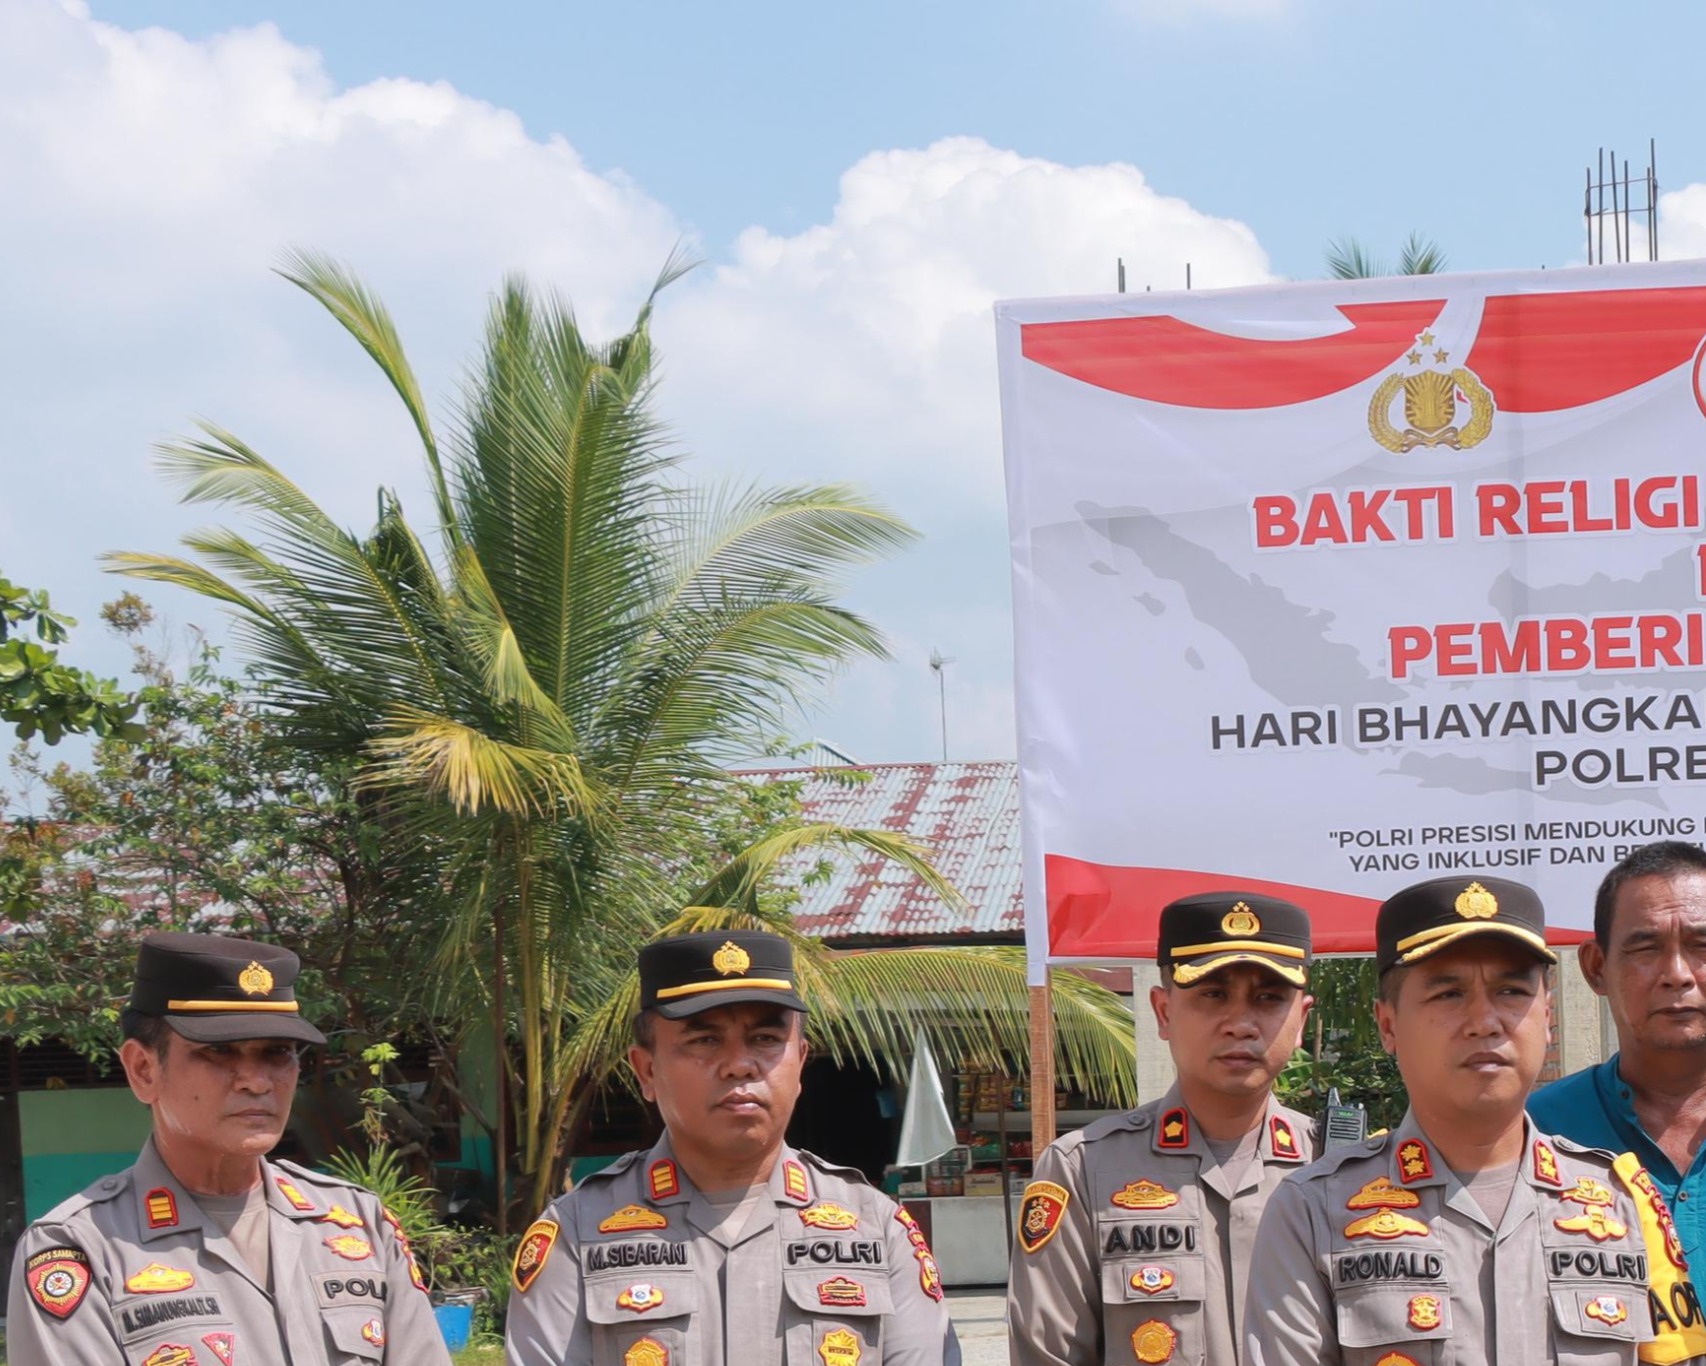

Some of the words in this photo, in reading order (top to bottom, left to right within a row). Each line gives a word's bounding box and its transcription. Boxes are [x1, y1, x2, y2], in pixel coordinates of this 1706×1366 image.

[1253, 486, 1454, 547] BAKTI
[1477, 474, 1699, 536] RELIGI
[1211, 710, 1337, 750] HARI
[1329, 828, 1413, 848] "POLRI
[1421, 824, 1516, 845] PRESISI
[1524, 817, 1696, 841] MENDUKUNG
[1349, 853, 1420, 872] YANG
[1428, 847, 1542, 869] INKLUSIF
[1550, 845, 1605, 865] DAN
[787, 1240, 882, 1265] POLRI
[1104, 1224, 1196, 1253] ANDI
[29, 1251, 52, 1270] KORPS
[1338, 1251, 1443, 1282] RONALD
[1551, 1250, 1647, 1281] POLRI
